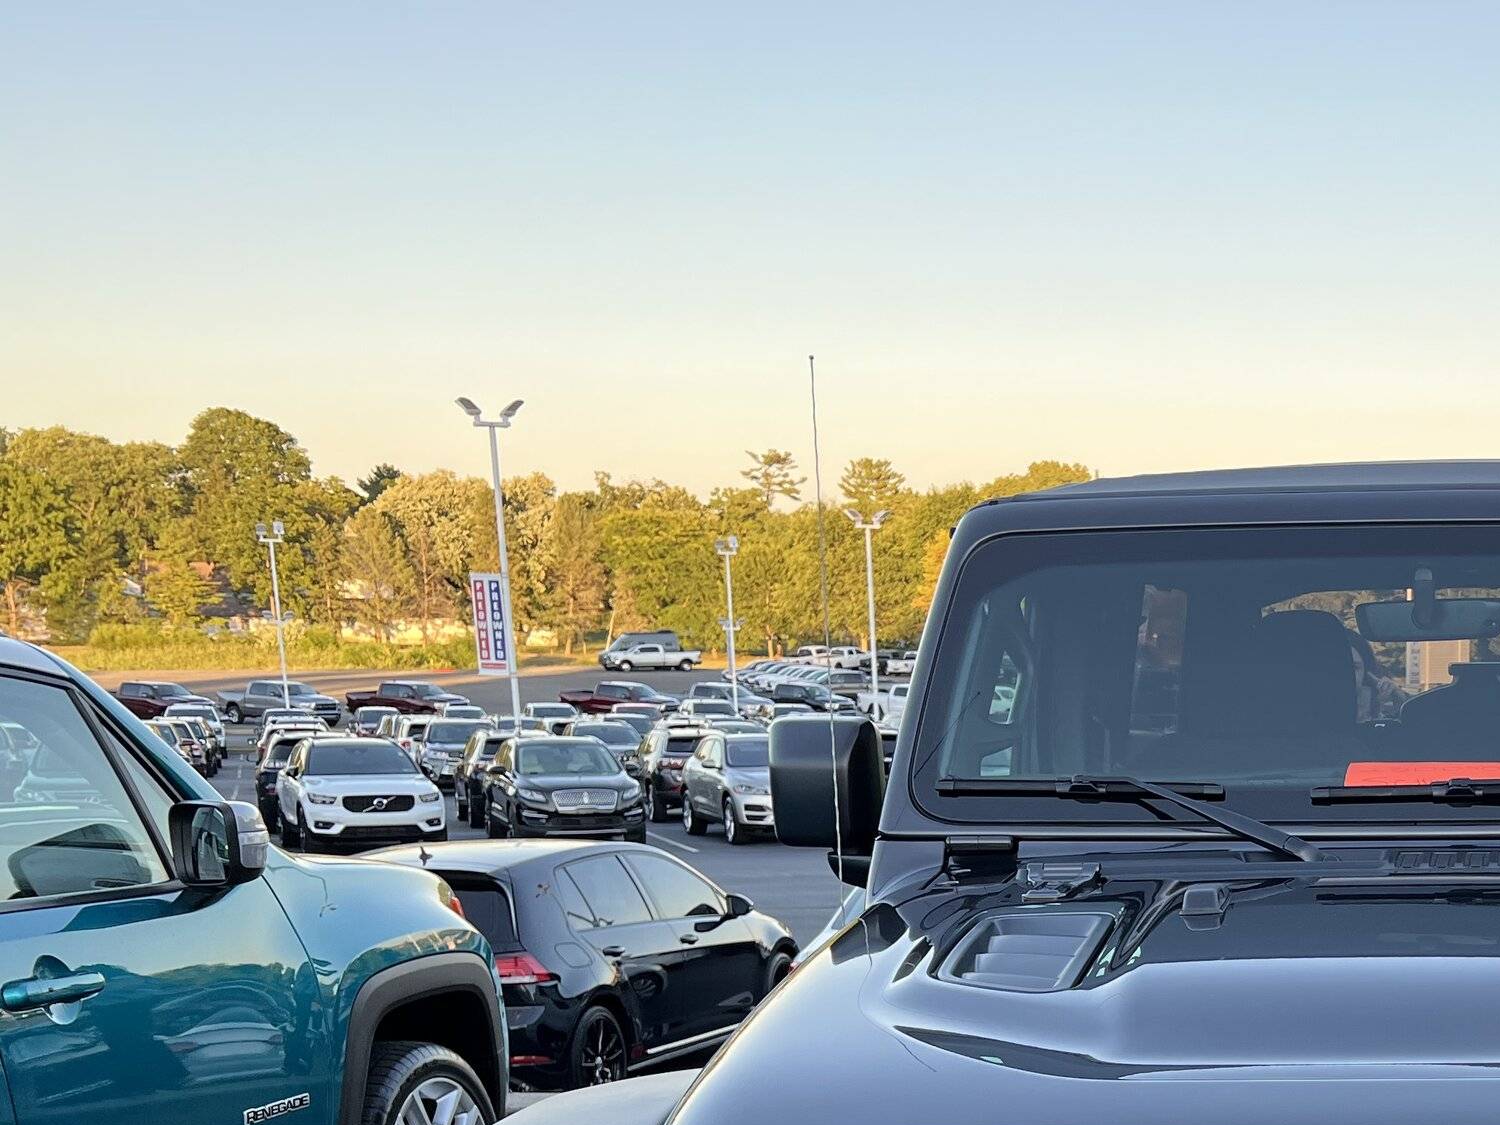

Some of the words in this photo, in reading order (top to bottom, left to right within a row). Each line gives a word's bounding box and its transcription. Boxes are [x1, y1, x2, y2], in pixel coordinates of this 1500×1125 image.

[475, 581, 489, 660] PREOWNED
[490, 581, 506, 660] PREOWNED
[244, 1093, 310, 1125] RENEGADE
